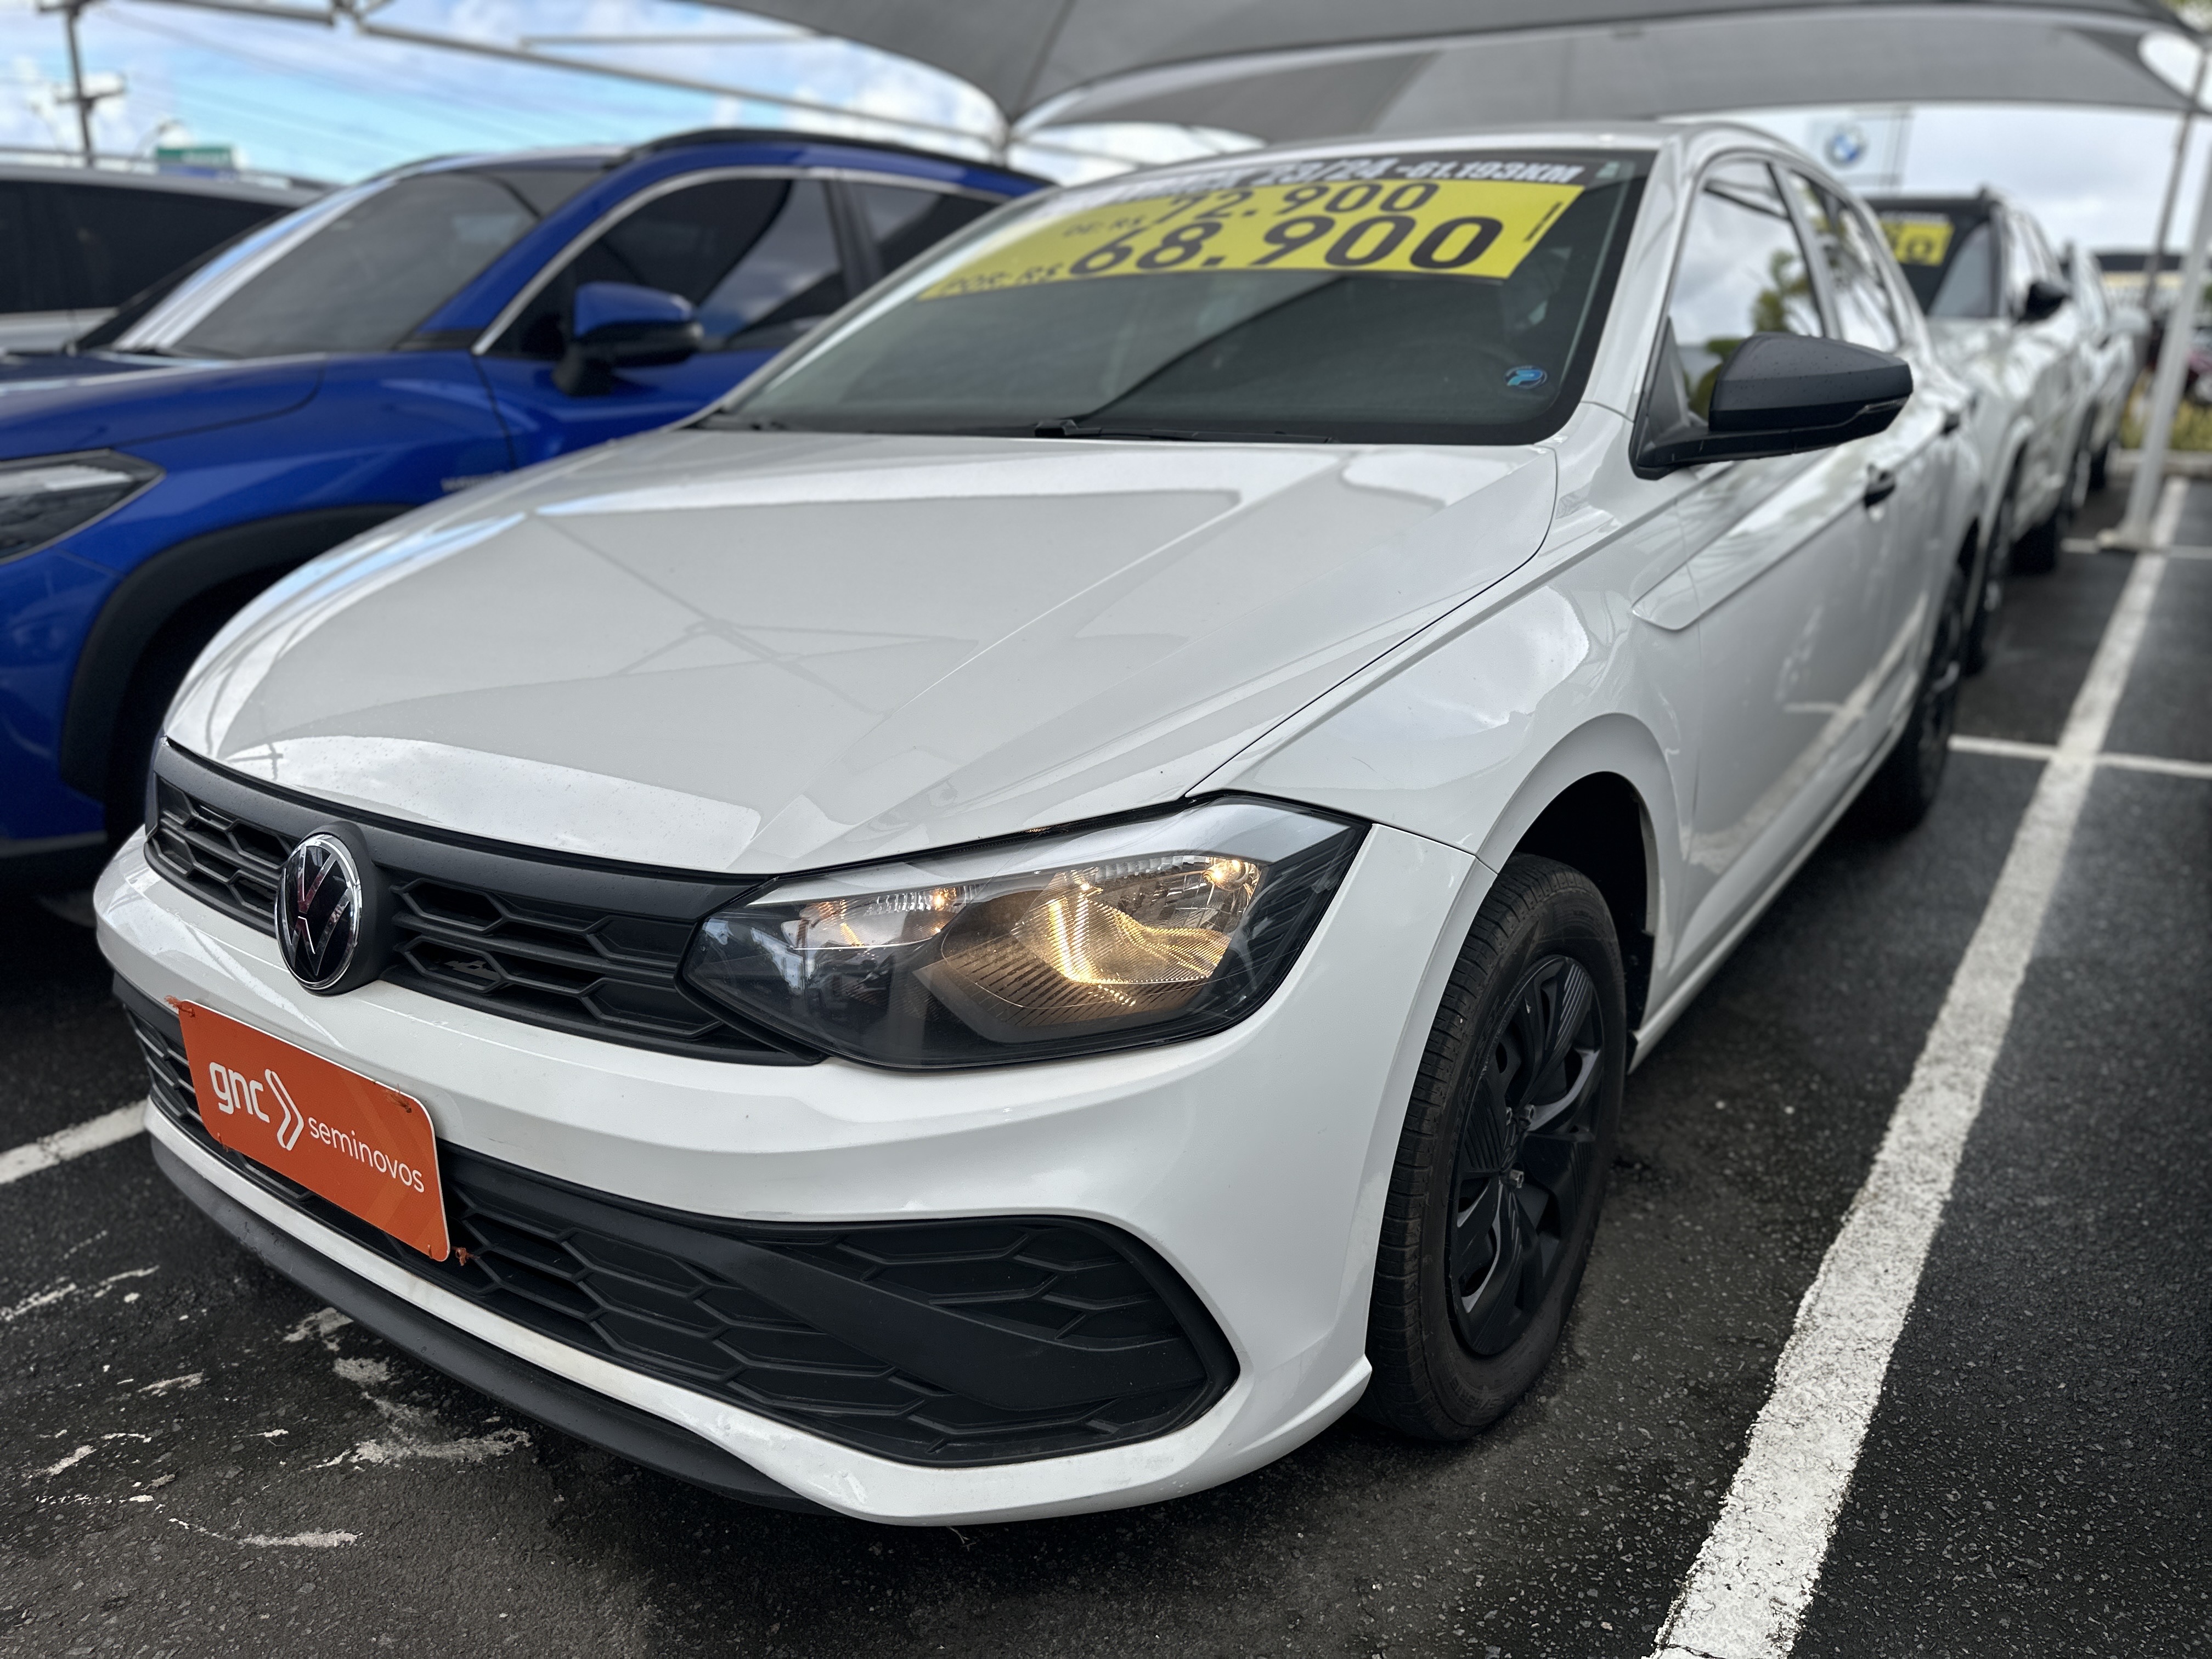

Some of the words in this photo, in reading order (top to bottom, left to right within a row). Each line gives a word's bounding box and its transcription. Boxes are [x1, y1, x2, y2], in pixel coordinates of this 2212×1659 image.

[1154, 182, 1440, 224] 72.900
[1069, 215, 1504, 275] 68.900
[210, 1062, 270, 1123] gnc
[308, 1117, 425, 1193] seminovos
